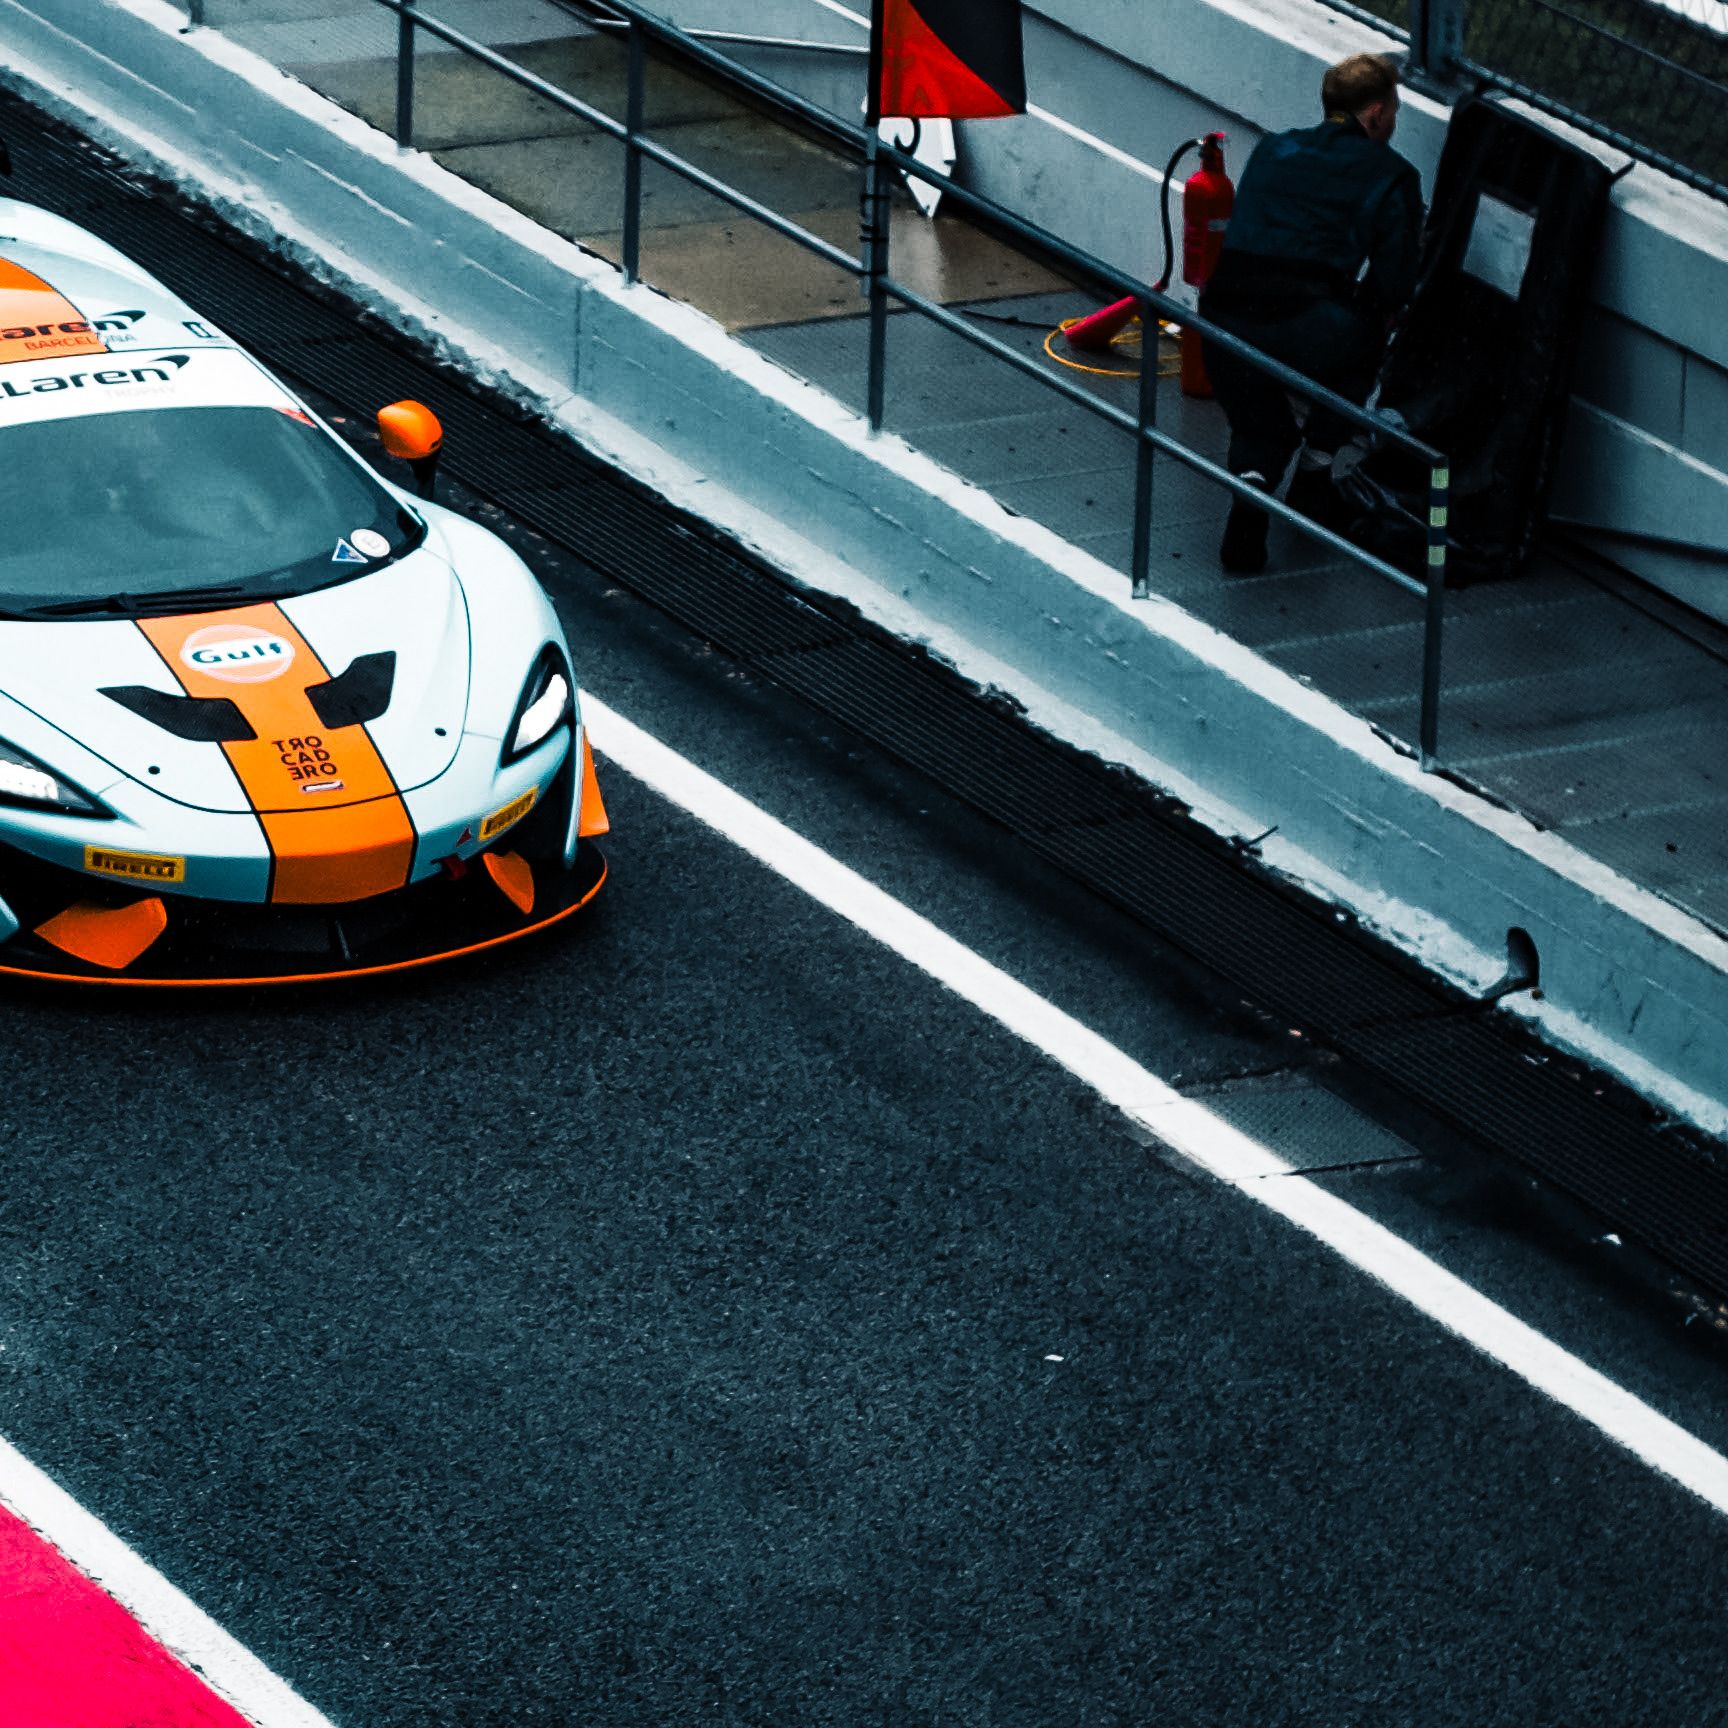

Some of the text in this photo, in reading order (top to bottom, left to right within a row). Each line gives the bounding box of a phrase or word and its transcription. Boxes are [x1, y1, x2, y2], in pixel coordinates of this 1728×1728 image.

[191, 641, 282, 664] Gulf
[271, 735, 323, 753] TRO
[280, 748, 331, 766] CAD
